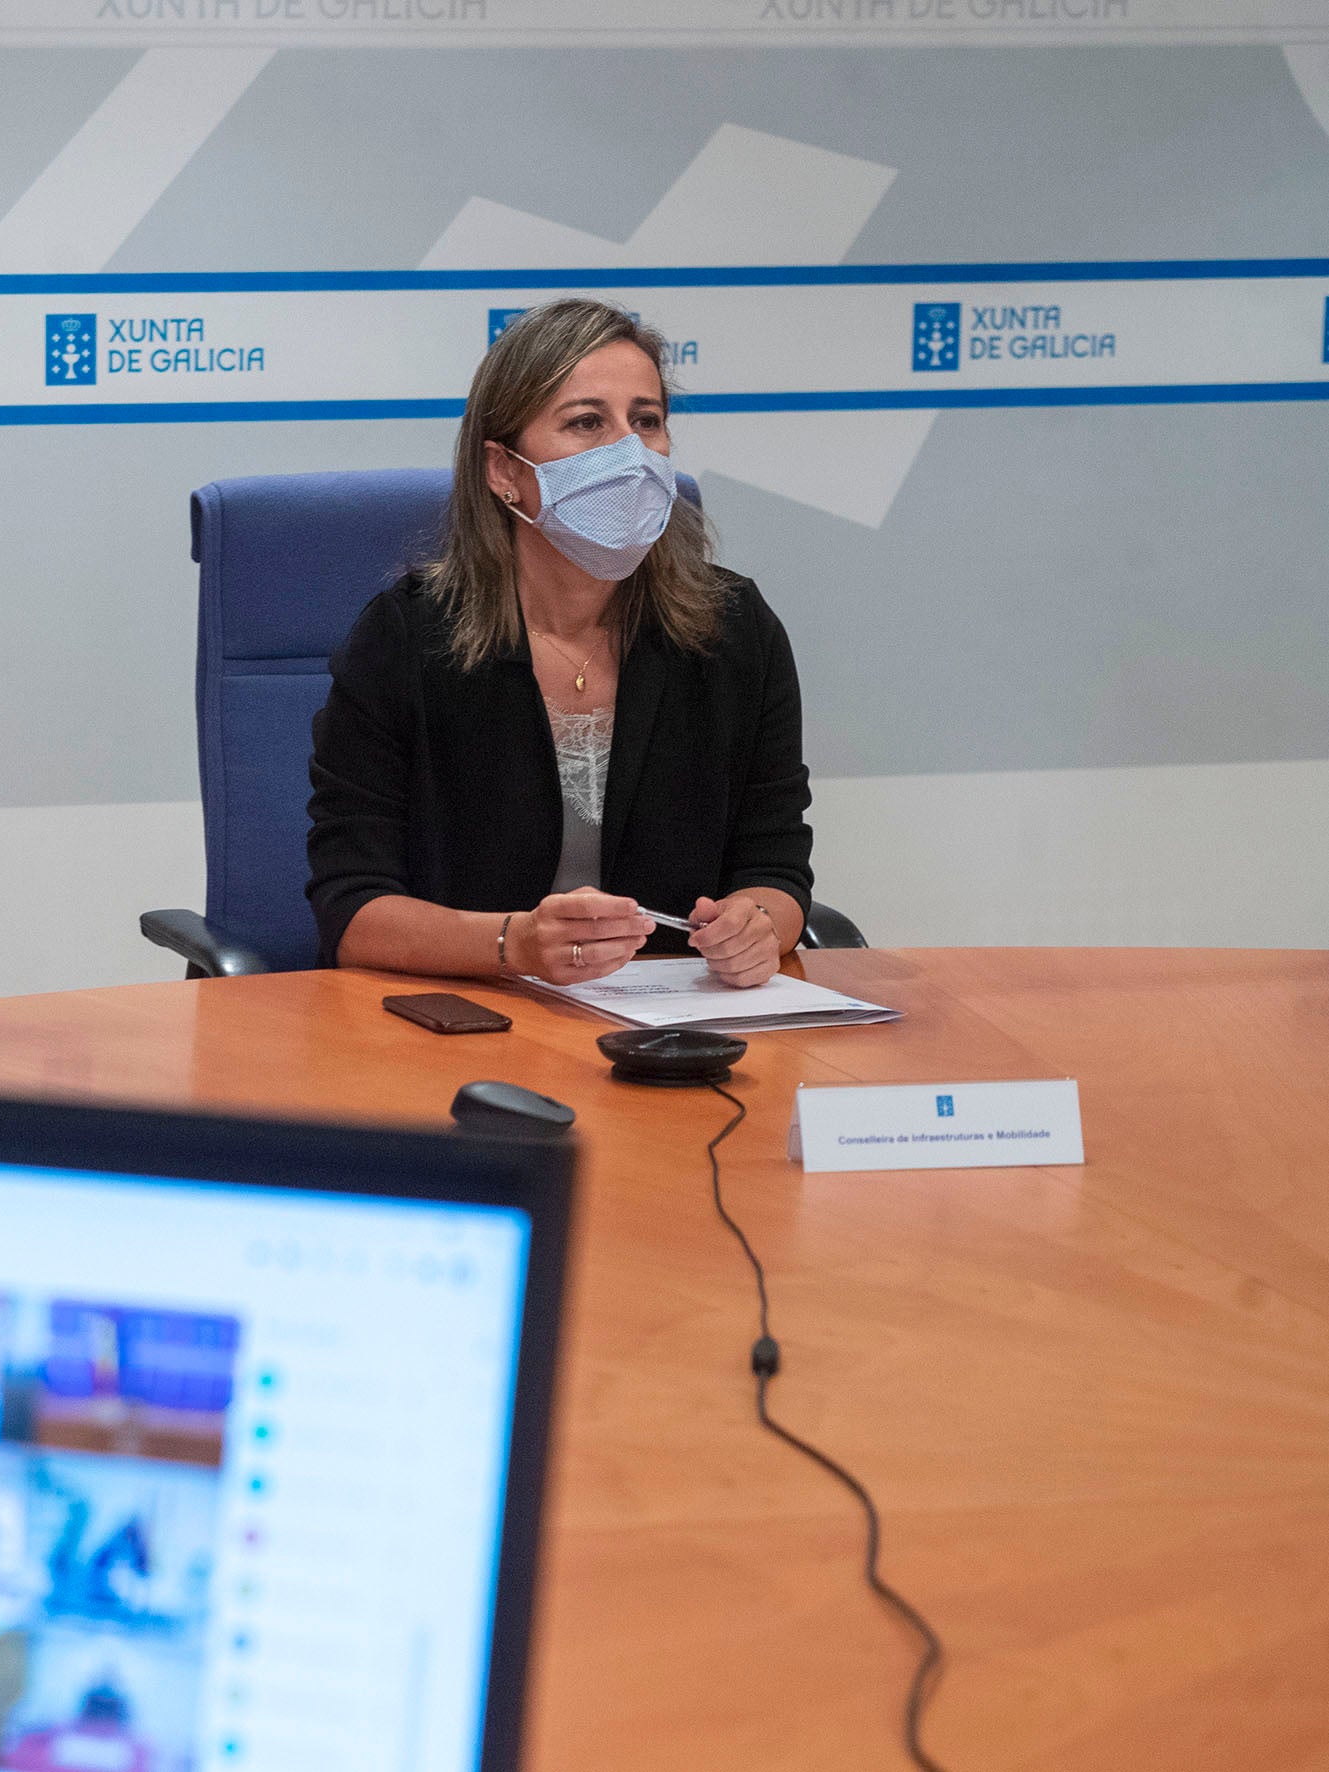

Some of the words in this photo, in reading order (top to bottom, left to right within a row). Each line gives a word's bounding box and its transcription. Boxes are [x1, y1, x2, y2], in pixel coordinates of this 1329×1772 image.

[108, 318, 204, 343] XUNTA
[971, 305, 1061, 331] XUNTA
[970, 335, 1003, 360] DE
[1008, 333, 1116, 359] GALICIA
[108, 349, 142, 373] DE
[150, 347, 265, 373] GALICIA
[838, 1133, 895, 1145] Conselleira
[897, 1134, 909, 1143] de
[912, 1131, 985, 1143] Infraestruturas
[996, 1129, 1051, 1140] Mobilidade
